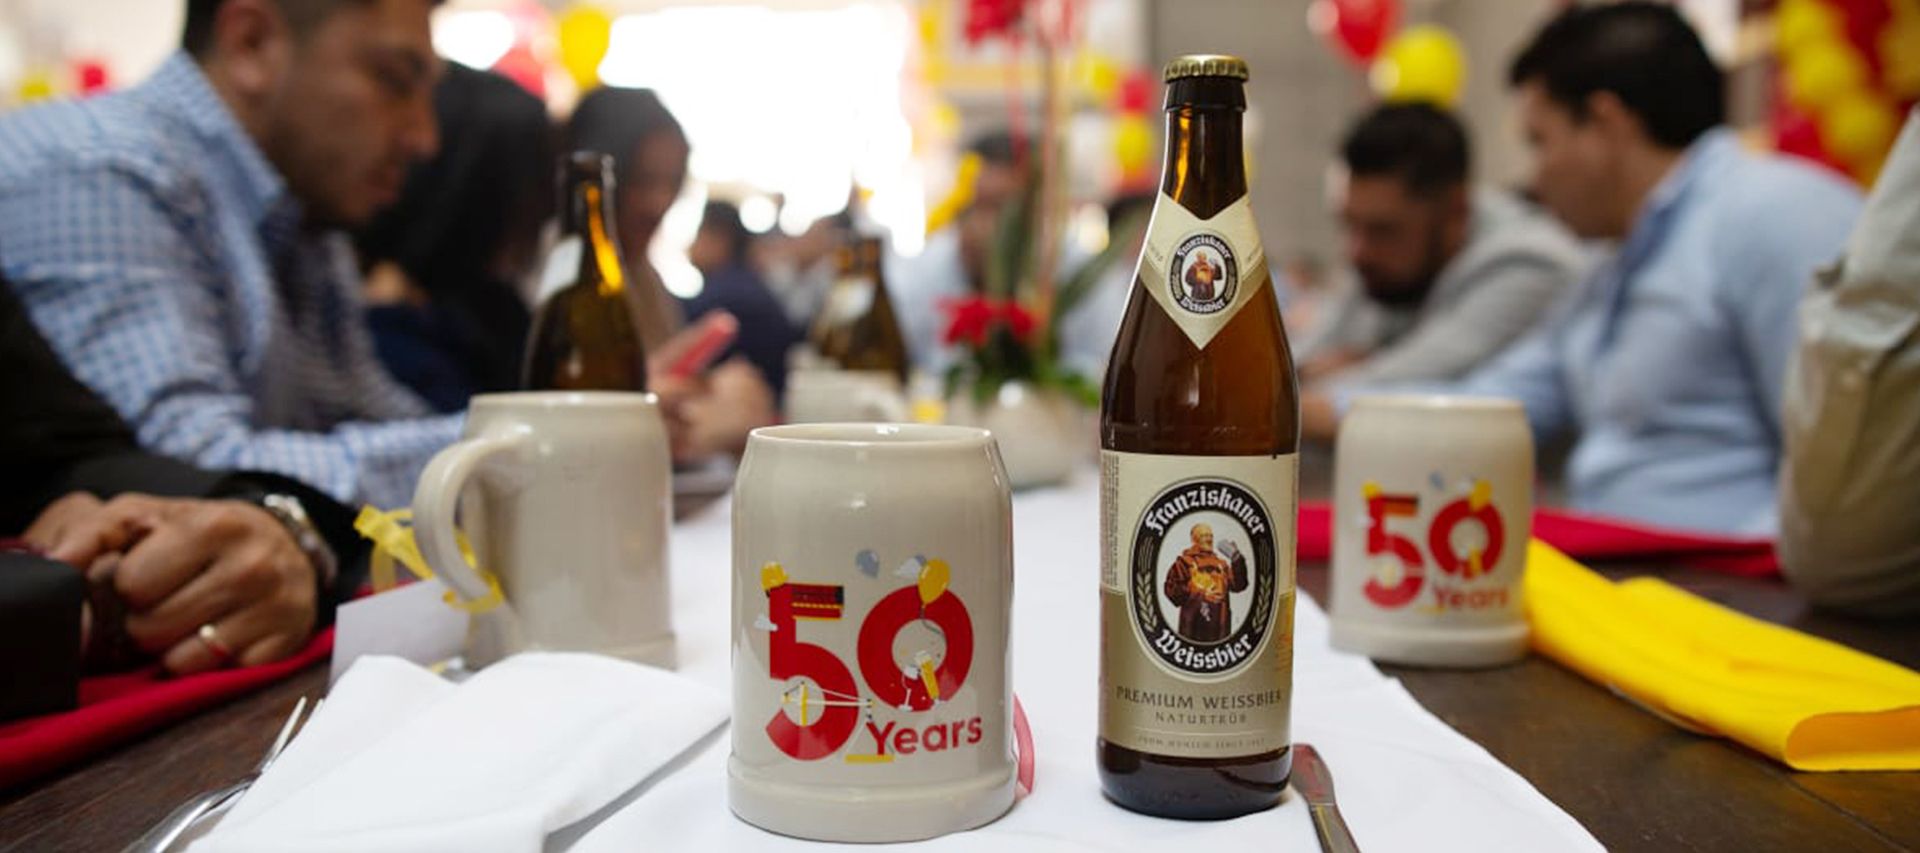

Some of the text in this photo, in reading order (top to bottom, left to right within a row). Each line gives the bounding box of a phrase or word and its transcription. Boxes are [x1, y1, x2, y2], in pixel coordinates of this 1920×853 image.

[1145, 486, 1265, 536] Franziskaner
[1363, 495, 1505, 610] 50
[765, 582, 974, 761] 50
[1154, 629, 1253, 670] Weissbier
[1116, 686, 1193, 709] PREMIUM
[866, 717, 982, 756] Years
